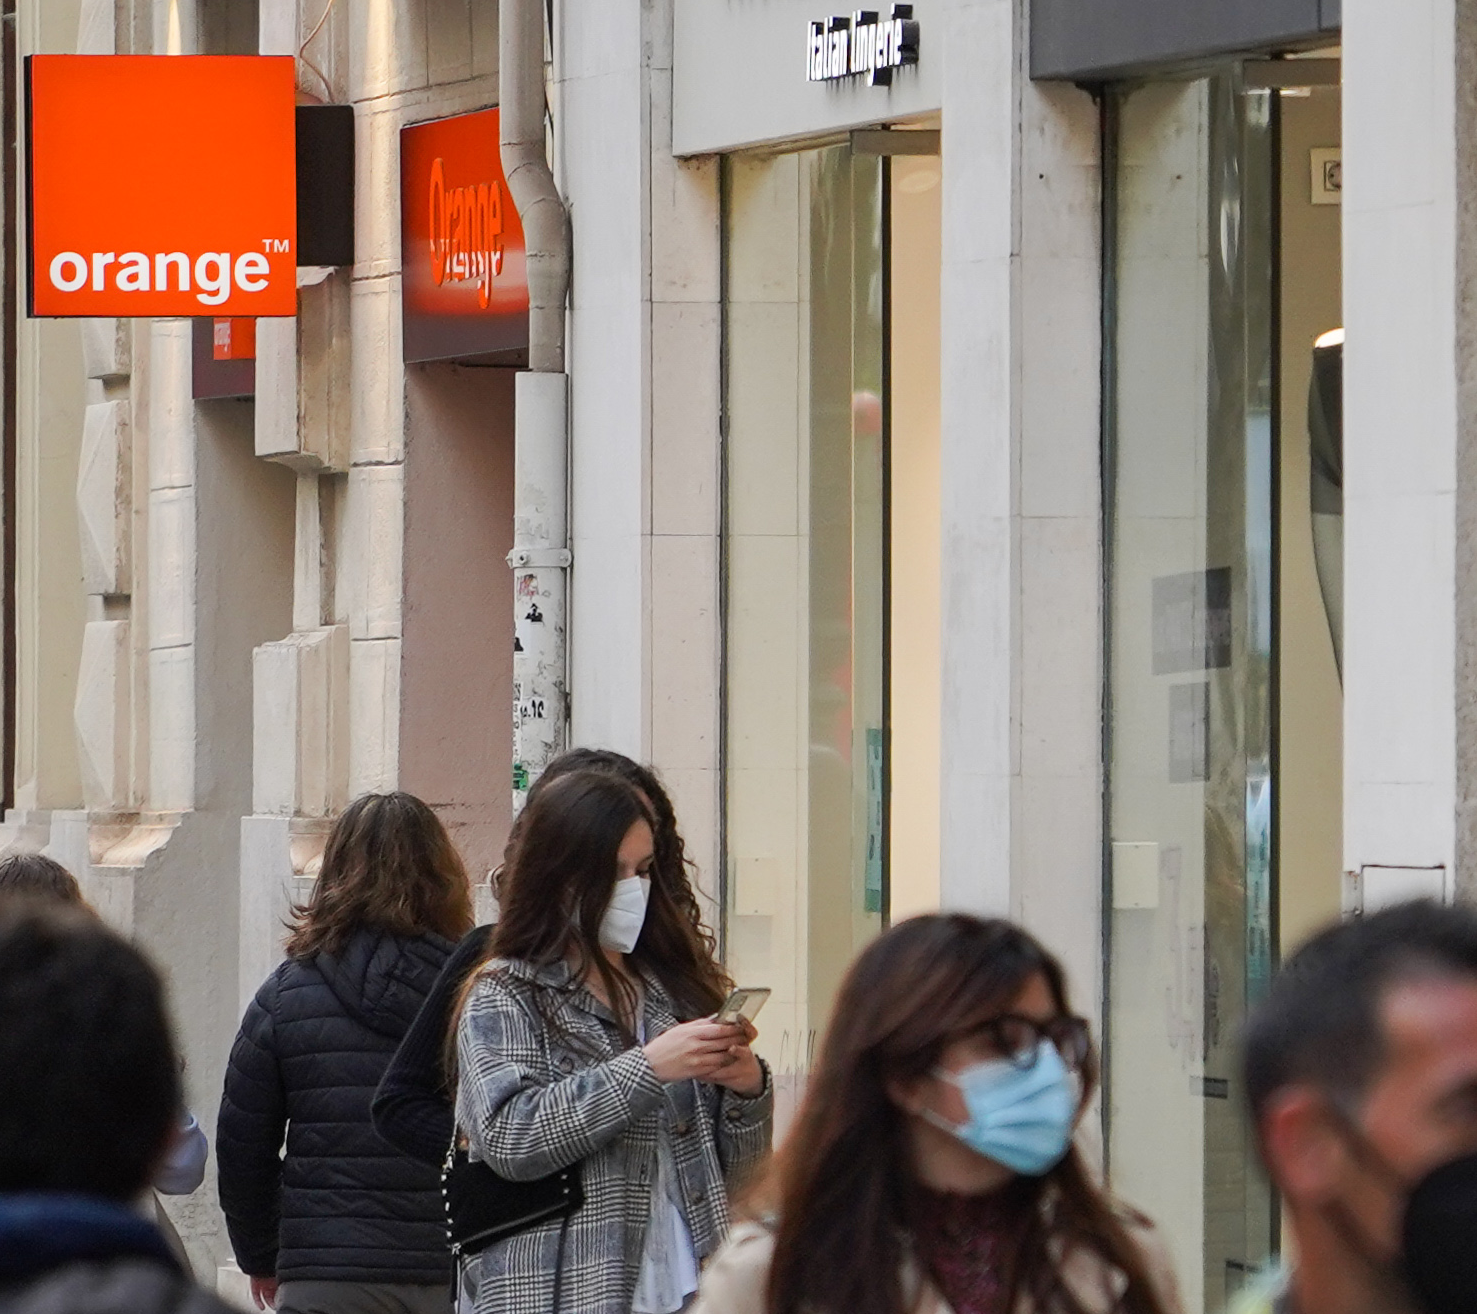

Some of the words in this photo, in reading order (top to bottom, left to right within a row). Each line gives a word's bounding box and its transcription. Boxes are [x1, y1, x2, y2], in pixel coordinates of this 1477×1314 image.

[806, 15, 849, 82] Italian
[850, 3, 907, 87] lingerie
[428, 157, 504, 310] Orange
[48, 250, 270, 305] orange
